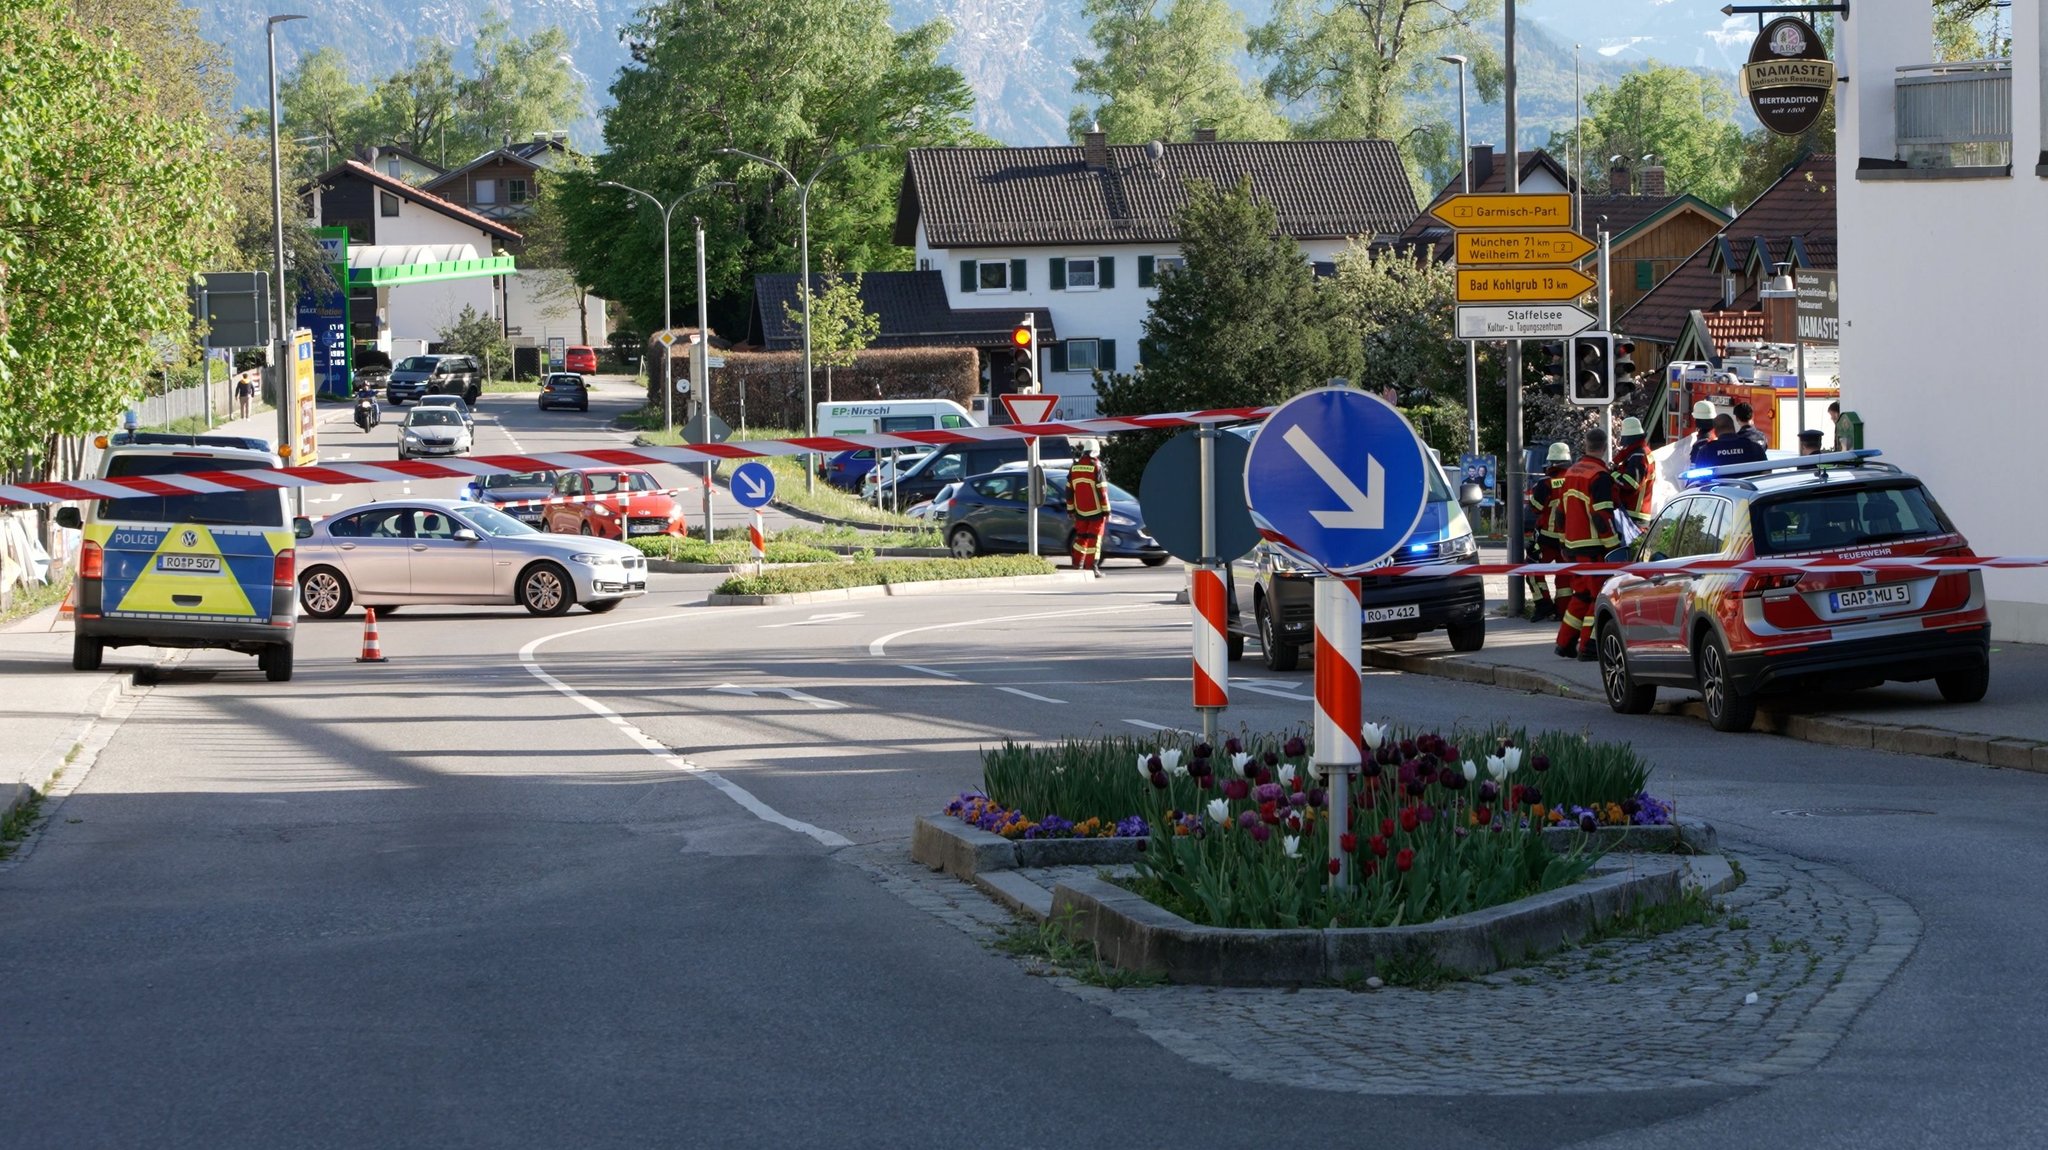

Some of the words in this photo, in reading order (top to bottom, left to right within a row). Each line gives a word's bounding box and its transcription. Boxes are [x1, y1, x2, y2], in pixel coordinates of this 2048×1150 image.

[1756, 65, 1825, 78] NAMASTE
[1752, 76, 1788, 86] Indisches
[1790, 76, 1830, 85] Restaurant
[1759, 96, 1819, 104] BIERTRADITION
[1477, 207, 1559, 216] Garmisch-Part.
[1471, 237, 1519, 247] München
[1524, 237, 1535, 246] 71
[1469, 250, 1519, 259] Weilheim
[1524, 250, 1535, 259] 21
[1470, 279, 1488, 291] Bad
[1493, 280, 1538, 293] Kohlgrub
[1543, 278, 1553, 289] 13
[1556, 281, 1568, 289] km
[1797, 300, 1823, 309] Restaurant
[1508, 311, 1562, 320] Staffelsee
[1487, 323, 1508, 332] Kultur-
[1517, 322, 1562, 333] Tagungszentrum
[1798, 315, 1838, 339] NAMASTE
[832, 407, 890, 416] EP:Nirschl
[115, 533, 158, 545] POLIZEI
[1838, 548, 1892, 560] FEUERWEHR
[166, 557, 181, 568] RO
[187, 559, 194, 568] P
[196, 558, 215, 569] 507
[1841, 592, 1866, 606] GAP
[1875, 588, 1892, 603] MU
[1896, 587, 1905, 600] 5
[1368, 610, 1381, 621] RO
[1387, 609, 1394, 619] P
[1397, 606, 1415, 618] 412
